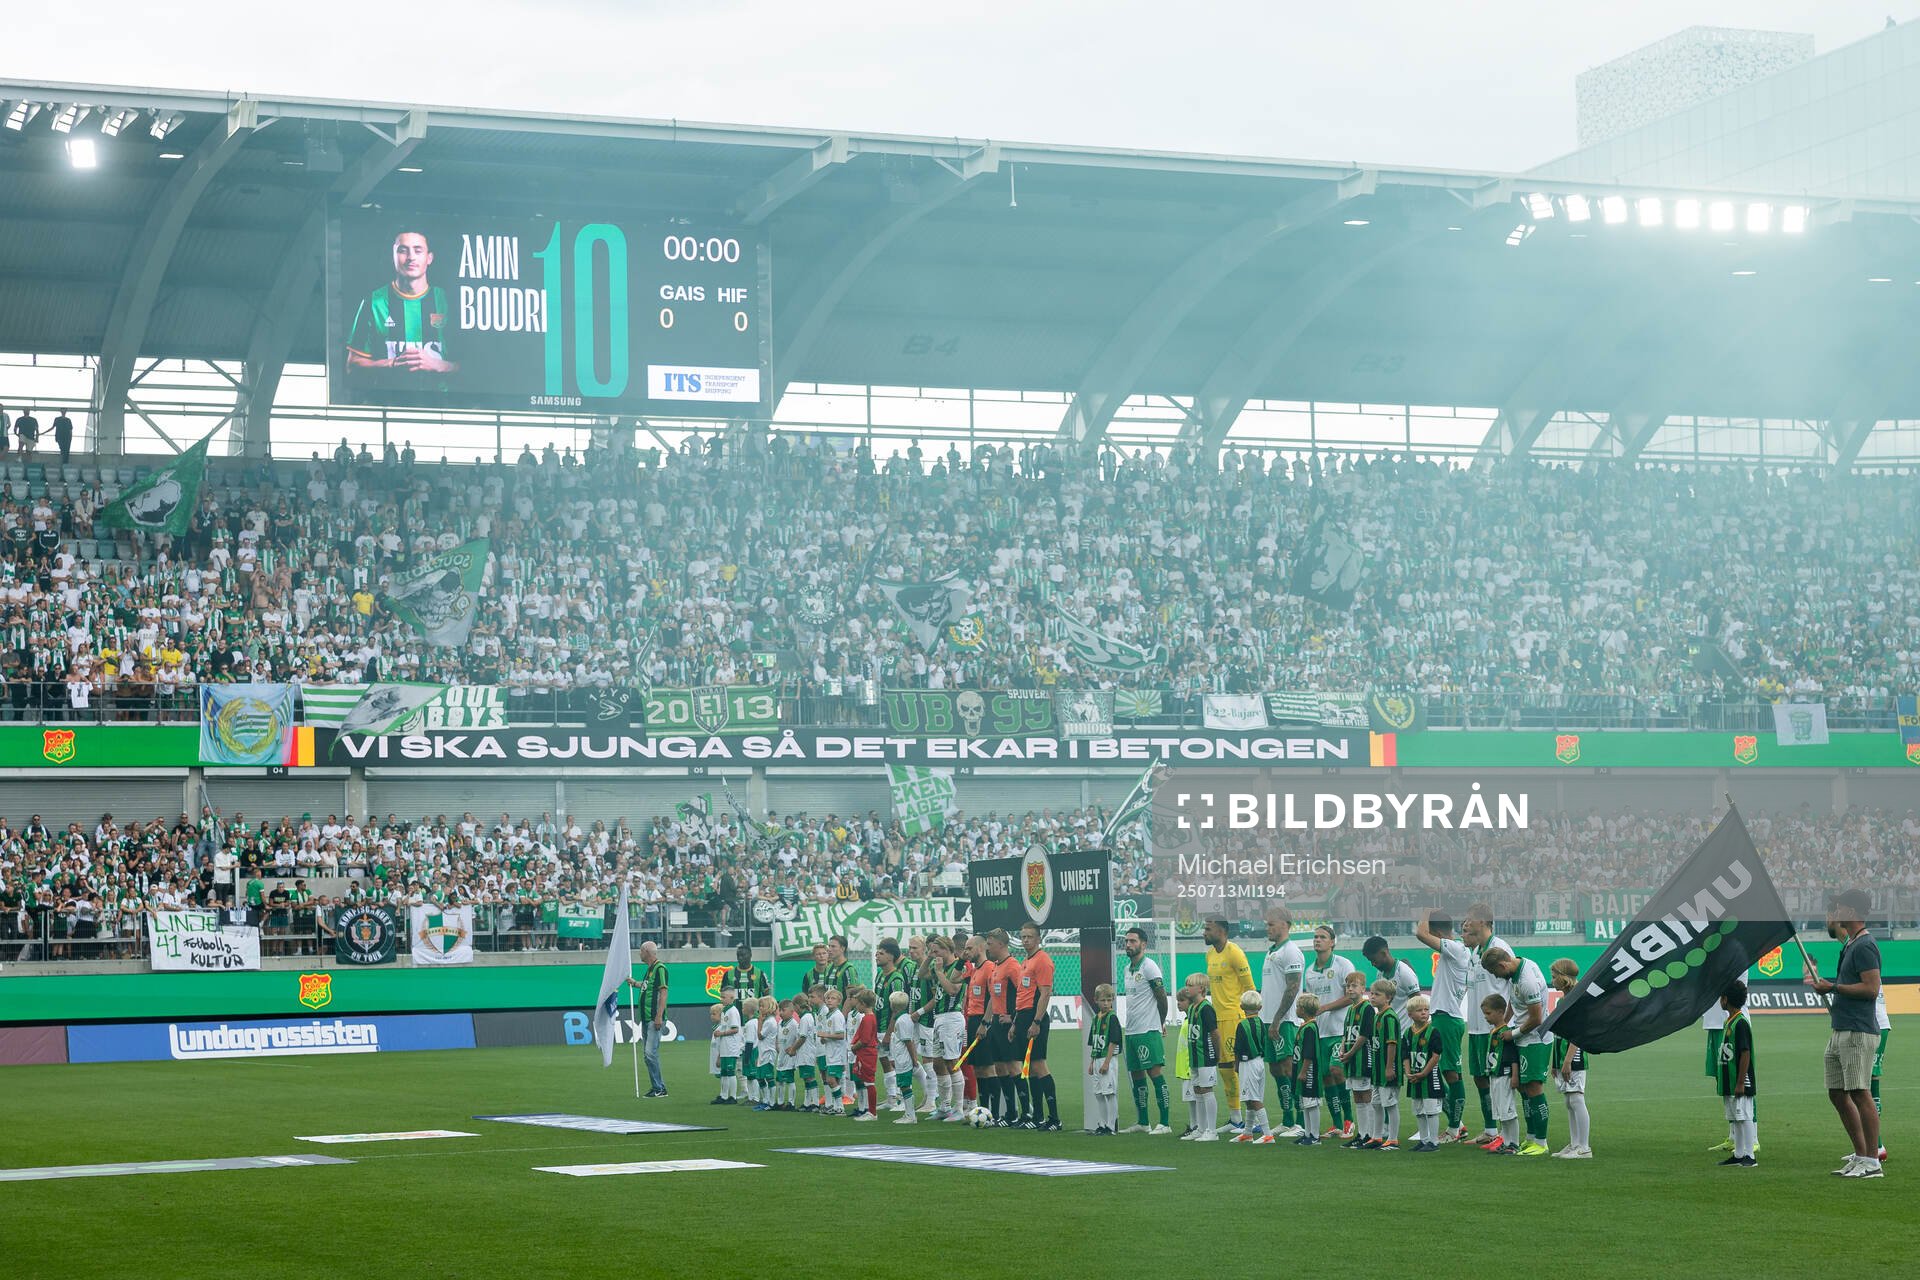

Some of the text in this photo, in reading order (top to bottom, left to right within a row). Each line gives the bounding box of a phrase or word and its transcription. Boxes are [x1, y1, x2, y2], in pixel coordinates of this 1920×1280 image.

[458, 234, 519, 280] AMIN
[663, 235, 740, 263] 00:00
[659, 284, 748, 304] GAIS HIF
[460, 285, 547, 333] BOUDRI
[532, 221, 629, 398] 10
[659, 307, 748, 332] 0 0
[663, 372, 702, 393] ITS
[529, 394, 582, 407] SAMSUNG
[427, 706, 509, 729] BOYS
[646, 699, 690, 724] 20
[732, 694, 775, 720] 13
[884, 692, 1053, 733] UB 99
[341, 729, 1349, 760] VI SKA SJUNGA SÅ DET EKAR I BETONGEN
[975, 875, 1014, 898] UNIBET
[1059, 868, 1101, 892] UNIBET
[1549, 920, 1573, 931] TOUR
[156, 935, 182, 958] 41
[350, 950, 383, 962] ON TOUR
[190, 951, 245, 969] KULTUR
[1772, 993, 1803, 1007] TILL
[169, 1020, 380, 1060] Lundagrossisten
